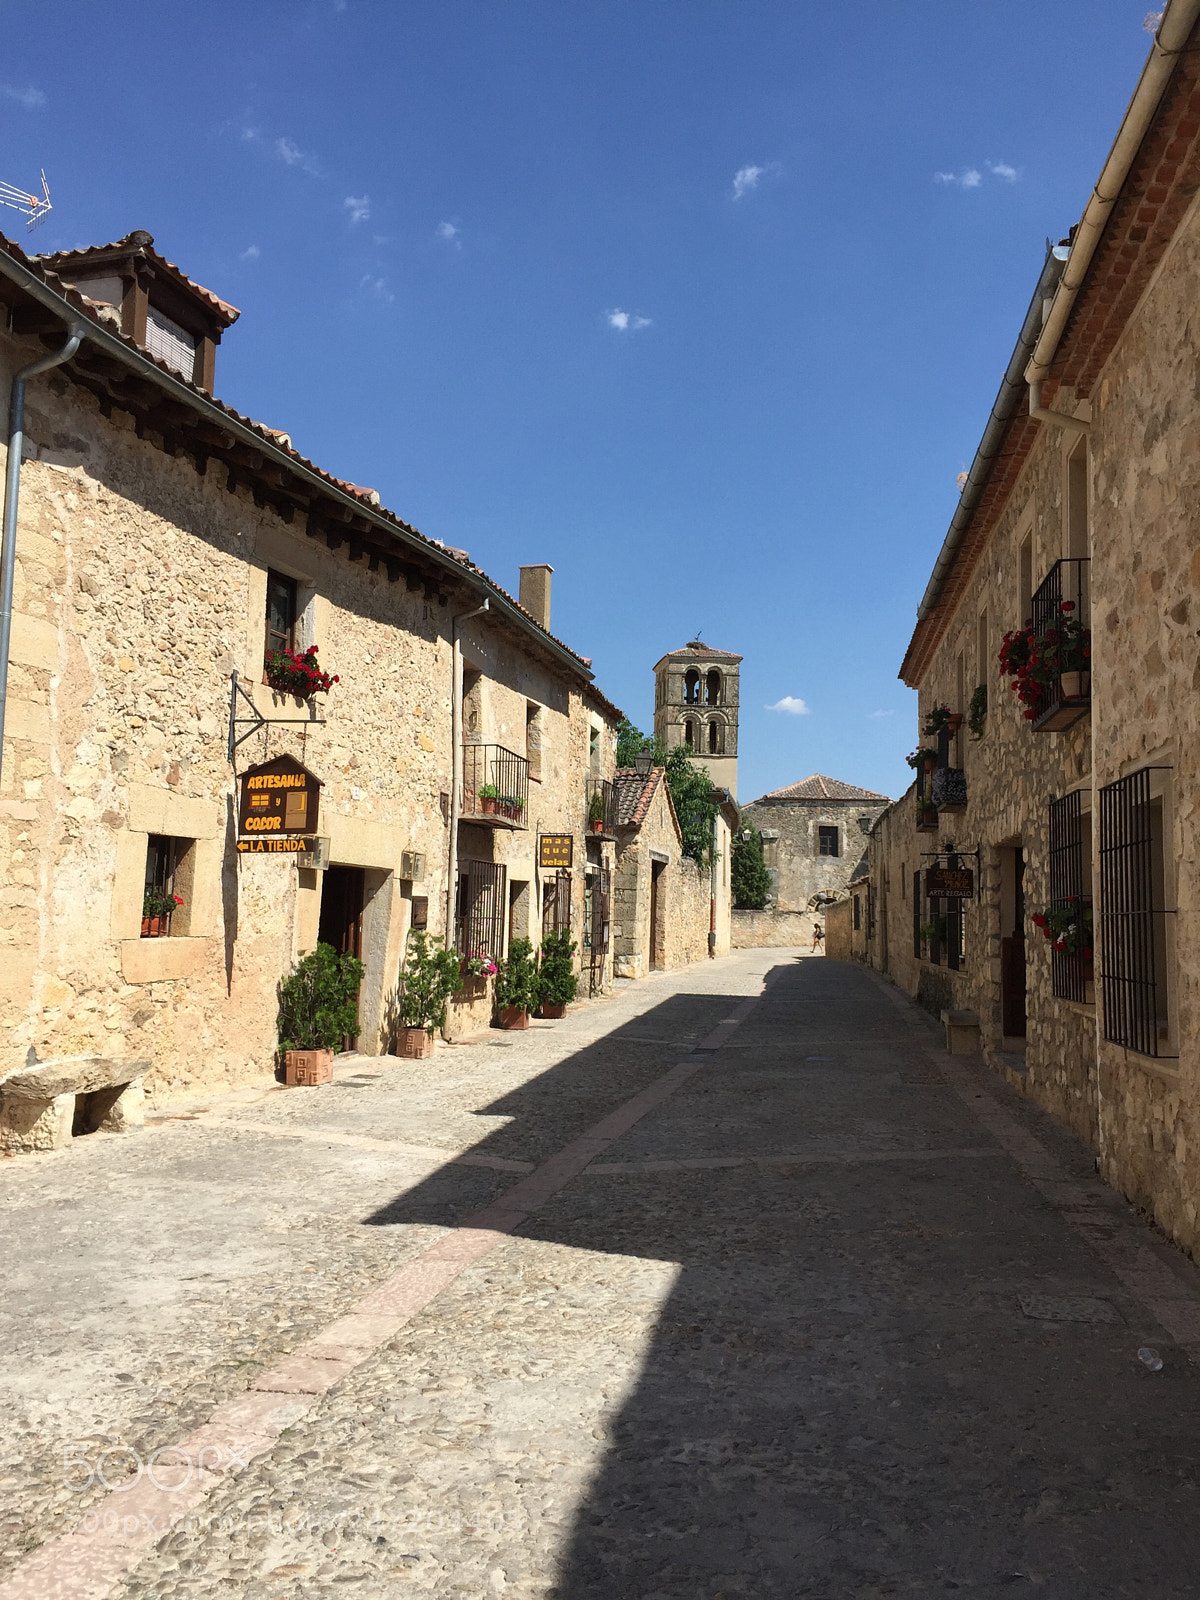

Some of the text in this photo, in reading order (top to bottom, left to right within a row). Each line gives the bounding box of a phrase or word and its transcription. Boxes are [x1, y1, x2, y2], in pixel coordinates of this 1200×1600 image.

[250, 840, 306, 852] LA TIENDA
[543, 847, 569, 855] que
[542, 858, 569, 866] velas
[945, 890, 972, 898] REGALO
